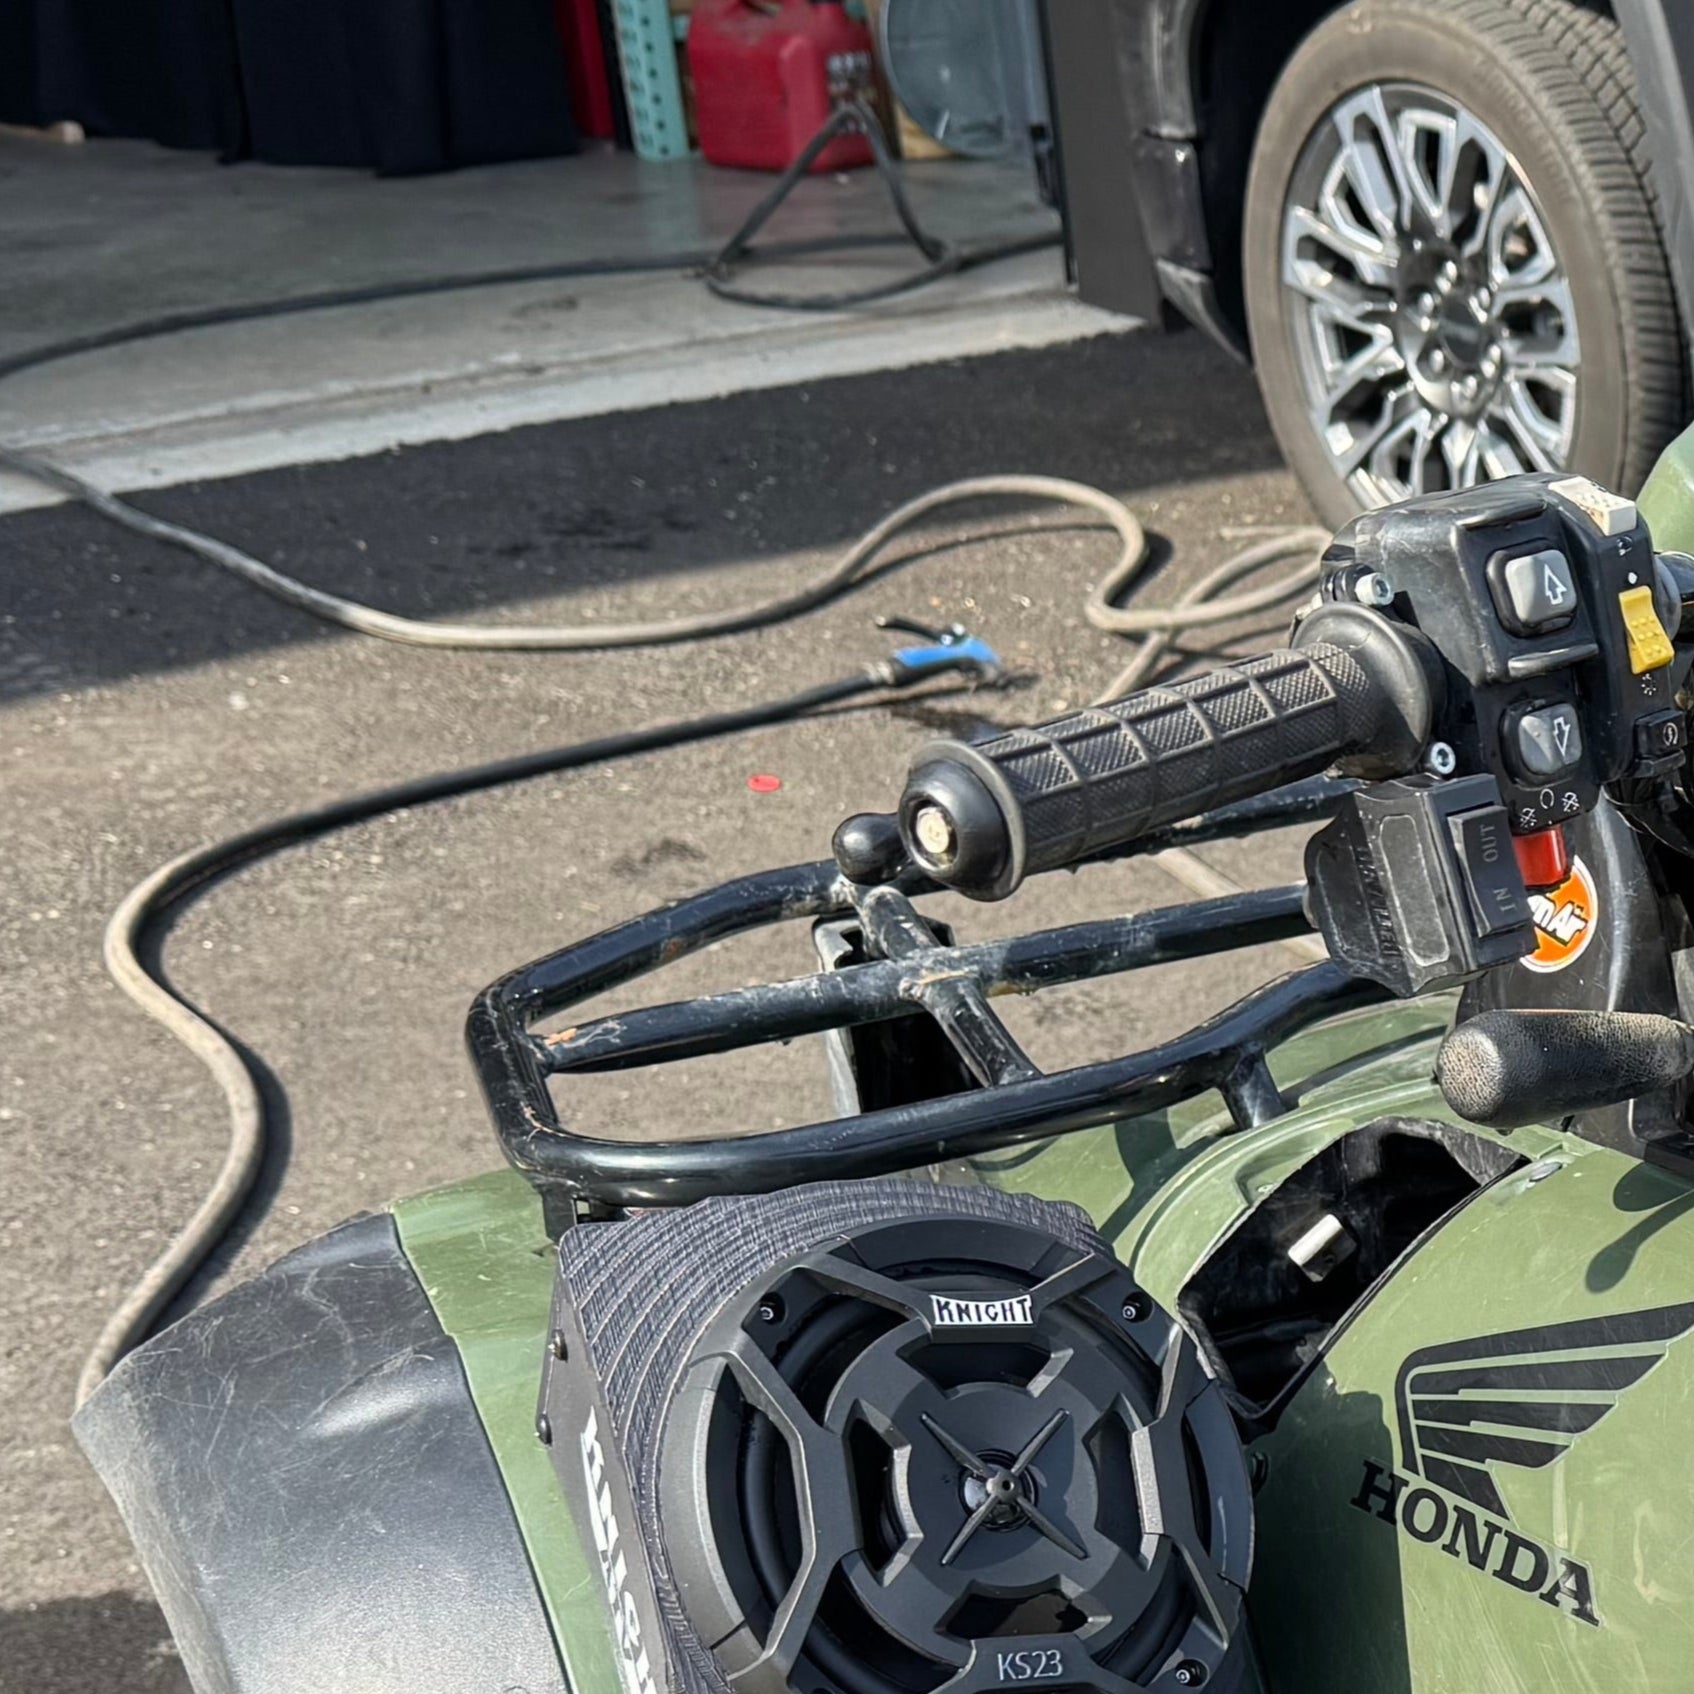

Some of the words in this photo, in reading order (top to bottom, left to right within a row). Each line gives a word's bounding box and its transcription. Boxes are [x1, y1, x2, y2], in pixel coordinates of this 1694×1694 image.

[1481, 823, 1499, 862] OUT
[1493, 886, 1517, 914] IN
[935, 1296, 1034, 1325] KNIGHT
[1349, 1458, 1601, 1628] HONDA
[996, 1650, 1064, 1681] KS23
